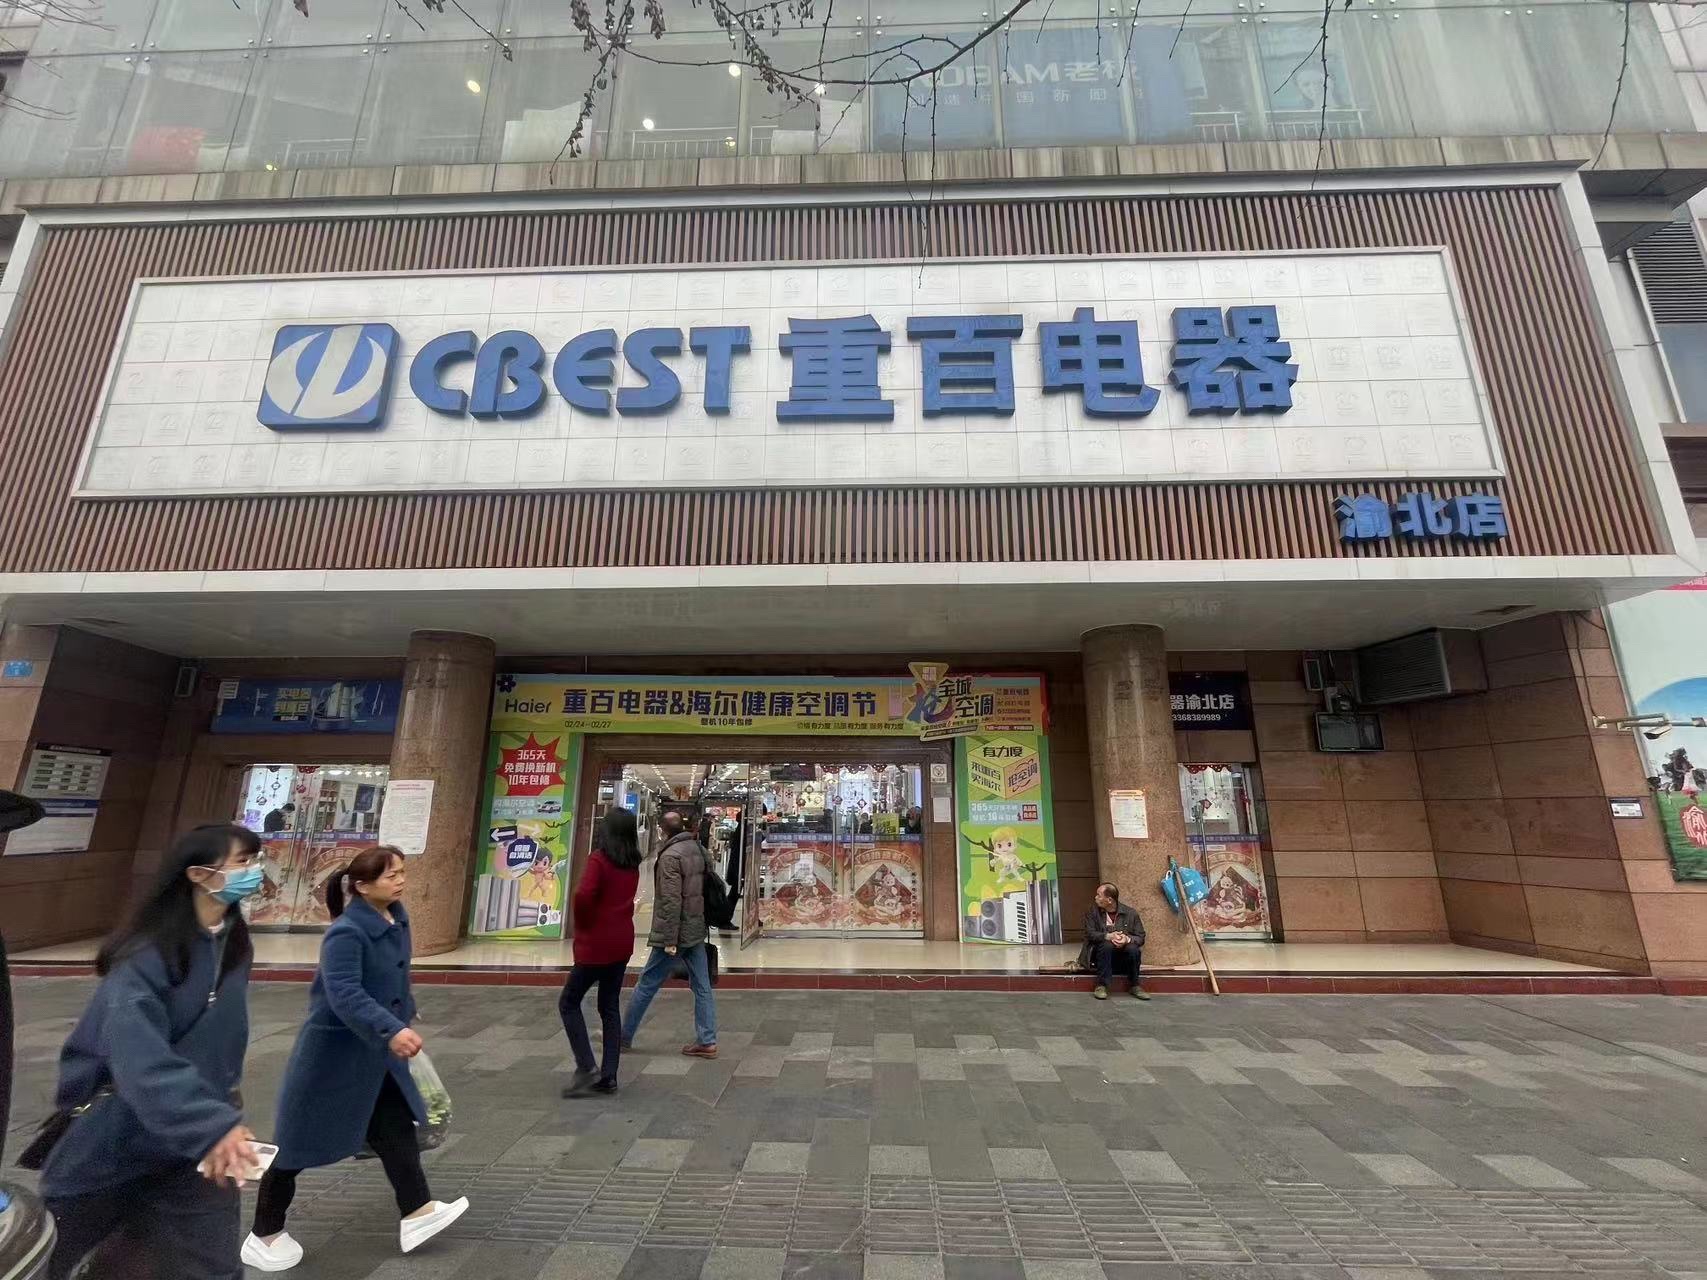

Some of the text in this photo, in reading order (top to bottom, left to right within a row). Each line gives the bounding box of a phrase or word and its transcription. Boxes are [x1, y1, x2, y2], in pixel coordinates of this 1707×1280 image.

[409, 305, 1299, 422] CBEST 重百电器
[1333, 492, 1509, 542] 渝北店
[939, 678, 972, 697] 全城
[504, 698, 552, 713] Haier
[562, 689, 876, 716] 重百电器&海尔健康空调节
[955, 694, 994, 718] 空调
[1169, 694, 1234, 710] 器渝北店
[517, 749, 546, 760] 365天
[983, 746, 1023, 758] 有力度
[508, 774, 550, 786] 10年包修
